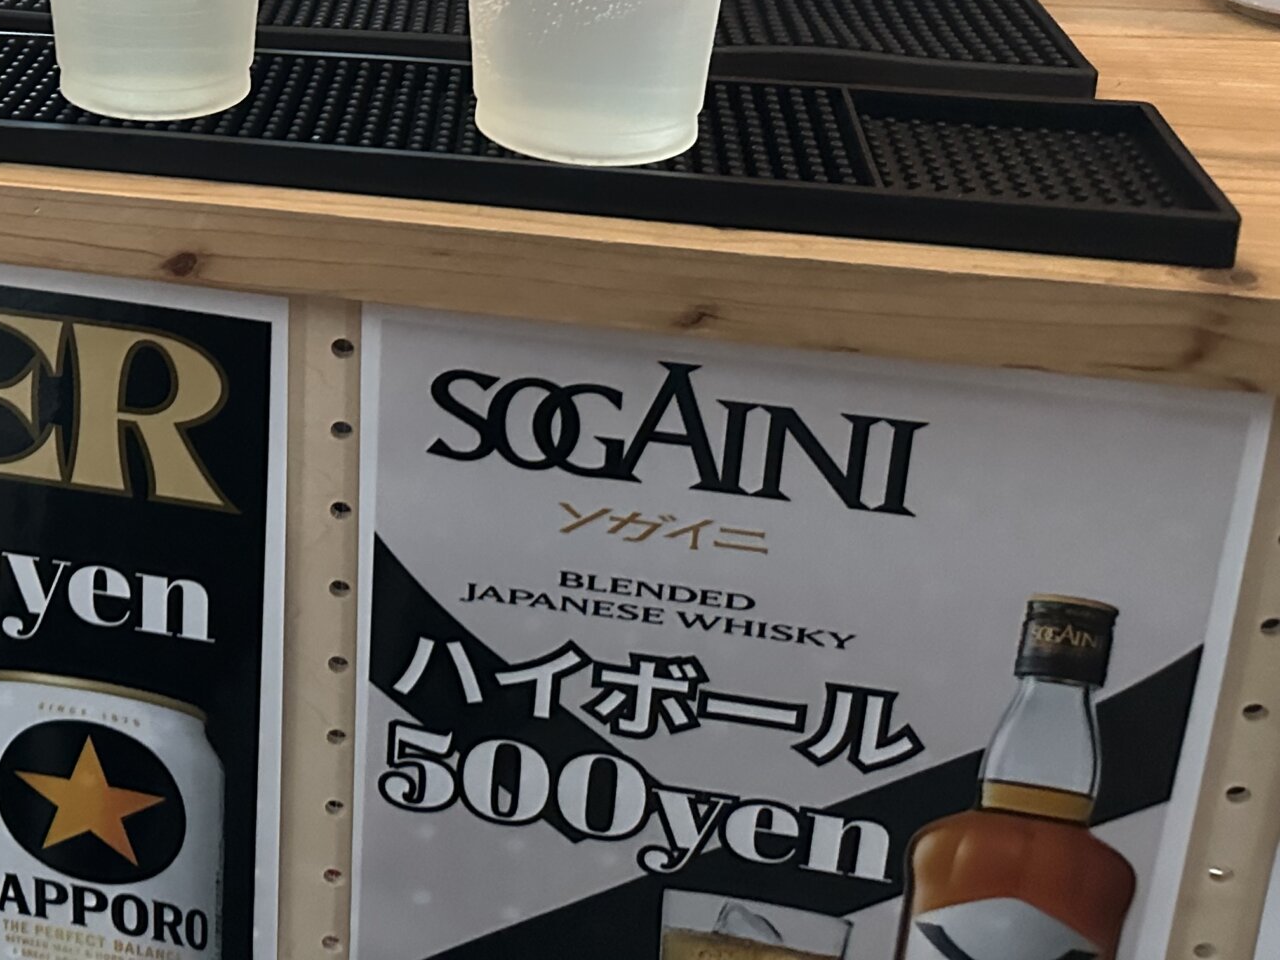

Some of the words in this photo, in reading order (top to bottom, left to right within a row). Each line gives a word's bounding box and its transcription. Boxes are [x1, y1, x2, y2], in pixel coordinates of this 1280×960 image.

[426, 360, 930, 517] SOGAINI
[558, 501, 769, 555] ソガイニ
[459, 582, 665, 626] JAPANESE
[676, 610, 857, 651] WHISKY
[558, 570, 757, 612] BLENDED
[391, 635, 924, 773] ハイボール
[378, 720, 894, 883] 500yen
[2, 918, 28, 934] THE
[34, 923, 106, 949] PERFECT
